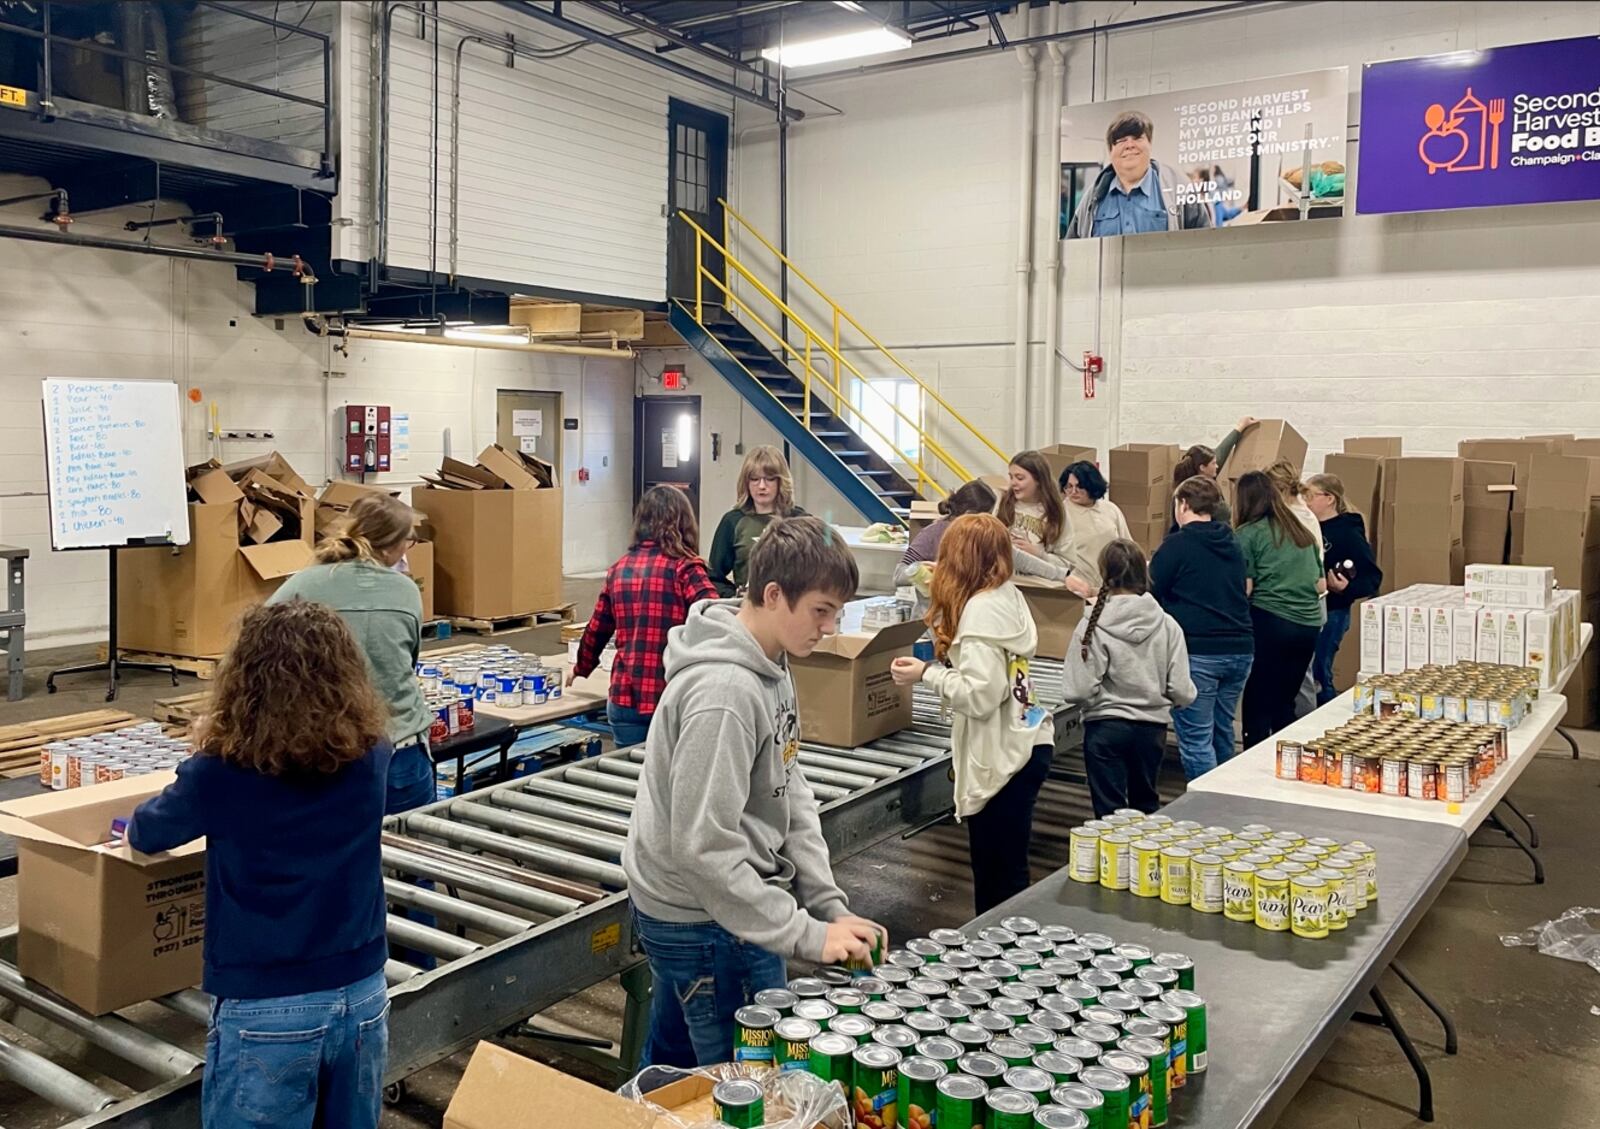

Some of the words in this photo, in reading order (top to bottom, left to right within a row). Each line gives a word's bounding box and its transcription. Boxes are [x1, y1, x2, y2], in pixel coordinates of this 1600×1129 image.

[1242, 89, 1309, 107] HARVEST
[1513, 87, 1600, 114] Second
[1179, 114, 1221, 128] FOOD
[1222, 109, 1262, 122] BANK
[1265, 102, 1311, 117] HELPS
[1513, 108, 1600, 133] Harvest
[1179, 127, 1200, 140] MY
[1204, 122, 1239, 137] WIFE
[1242, 119, 1273, 132] AND
[1277, 118, 1282, 128] I
[1179, 134, 1243, 151] SUPPORT
[1247, 131, 1278, 143] OUR
[1511, 128, 1579, 153] Food
[1585, 127, 1600, 147] B
[1178, 146, 1254, 164] HOMELESS
[1582, 150, 1600, 161] Cla
[1176, 181, 1217, 194] DAVID
[1176, 189, 1242, 205] HOLLAND
[664, 374, 679, 388] EXIT
[741, 1027, 775, 1042] MISSION
[787, 1042, 809, 1058] MISS
